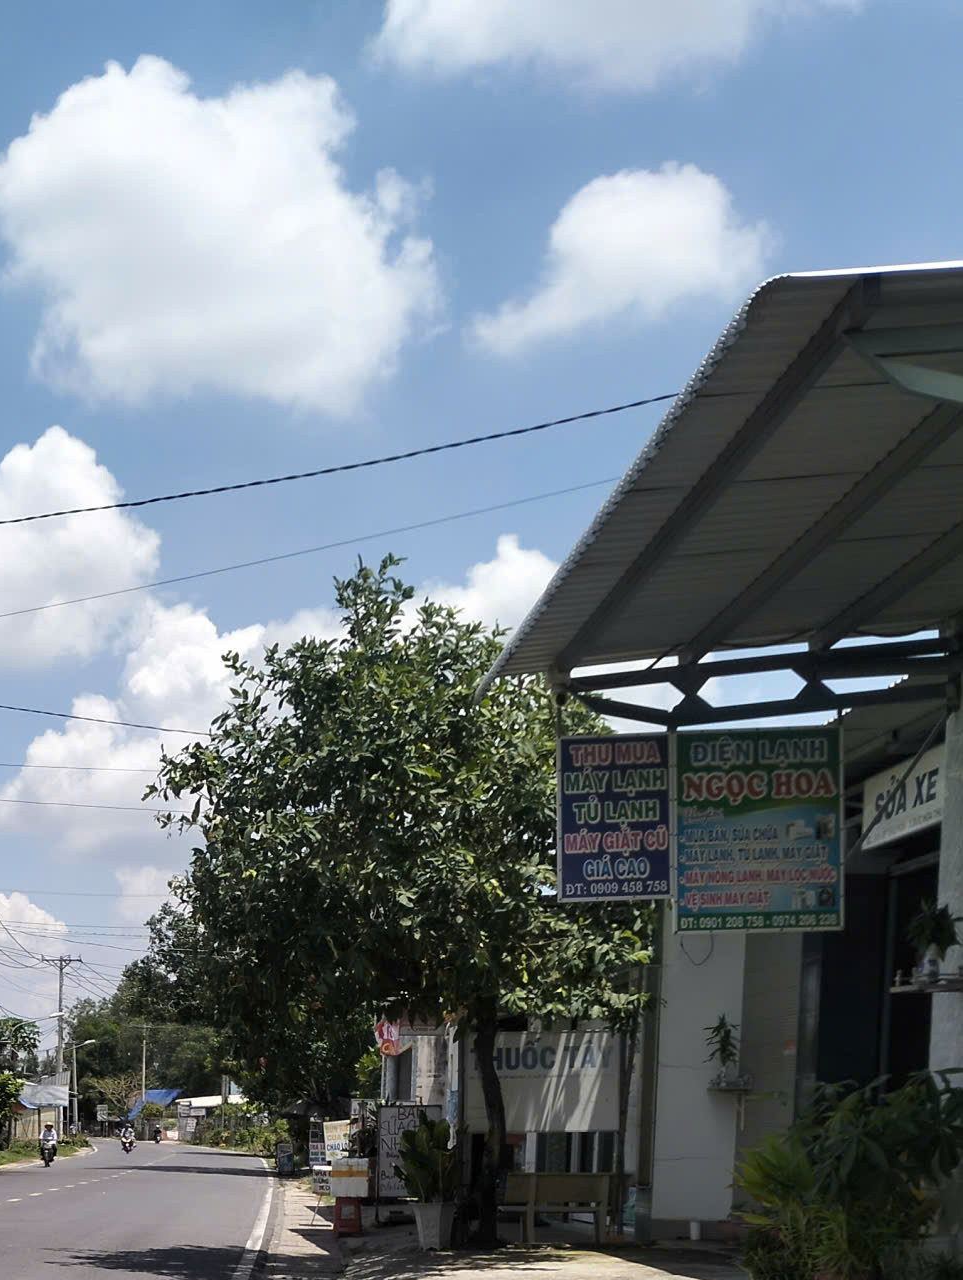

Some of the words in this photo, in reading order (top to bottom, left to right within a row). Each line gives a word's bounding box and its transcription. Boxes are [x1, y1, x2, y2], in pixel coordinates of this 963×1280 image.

[569, 743, 612, 767] THU
[615, 742, 661, 766] MUA
[691, 736, 755, 769] ĐIỆN
[758, 737, 828, 768] LẠNH
[564, 766, 609, 795] MÁY
[612, 768, 668, 797] LẠNH
[683, 771, 767, 806] NGỌC
[771, 768, 838, 799] HOA
[912, 767, 939, 809] XE
[573, 794, 600, 825] TỦ
[604, 799, 660, 828] LẠNH
[564, 828, 602, 855] MÁY
[603, 824, 642, 858] GIẶT
[643, 824, 668, 851] CŨ
[583, 854, 613, 881] GIÁ
[614, 856, 649, 880] CAO
[565, 883, 587, 896] ĐT:
[590, 882, 619, 895] 0909
[621, 881, 644, 894] 458
[646, 879, 668, 892] 758
[470, 1038, 557, 1071] HUỐC
[563, 1039, 613, 1069] TÂY
